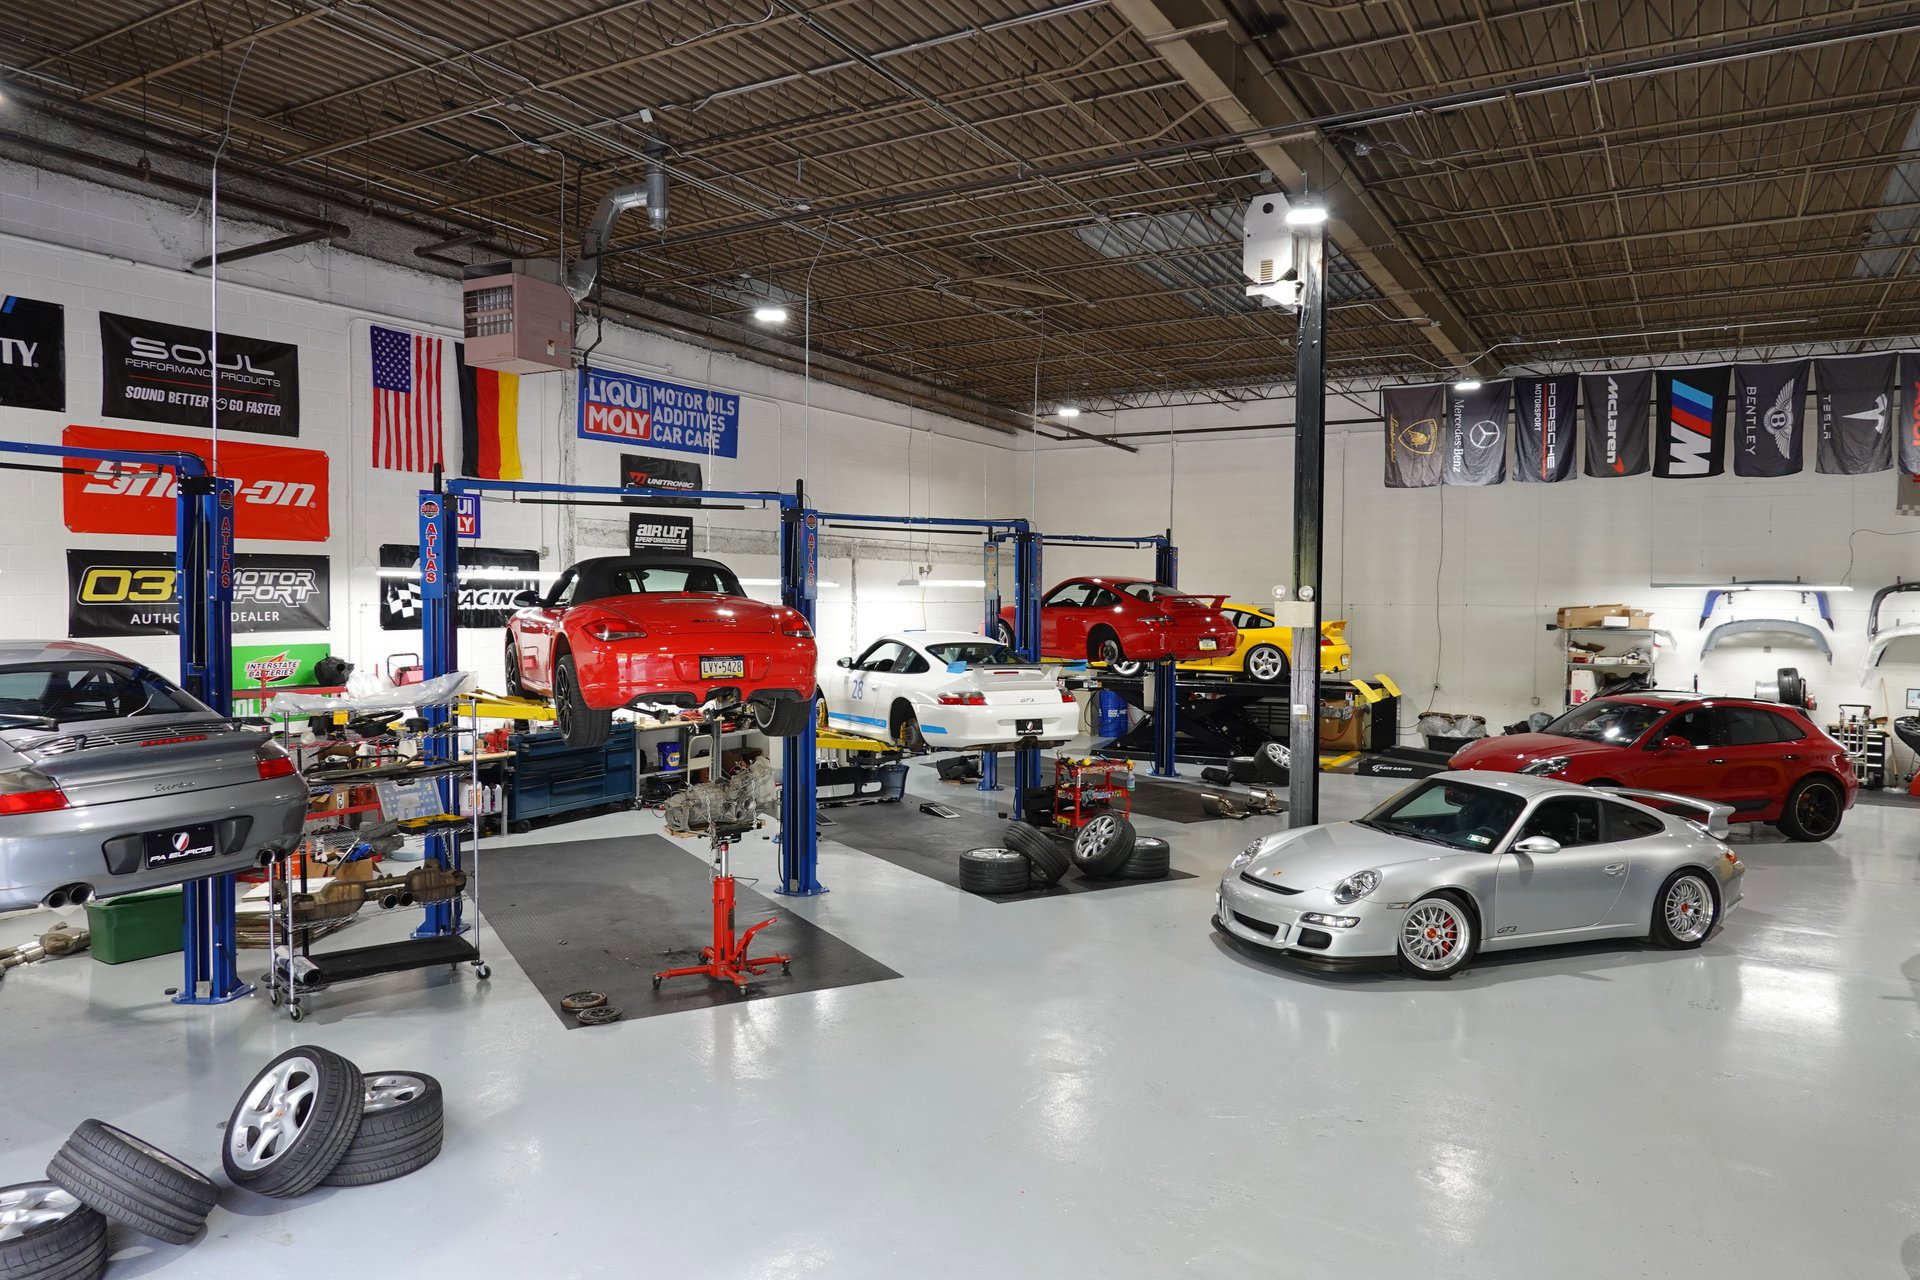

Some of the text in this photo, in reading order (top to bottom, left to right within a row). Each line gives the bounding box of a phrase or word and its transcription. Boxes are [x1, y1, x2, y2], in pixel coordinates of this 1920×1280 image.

[130, 336, 275, 376] SOUL
[125, 357, 281, 388] PERFORMANCE PRODUCTS
[125, 385, 281, 417] SOUND BETTER GO FASTER
[588, 377, 648, 410] LIQUI
[653, 386, 735, 416] MOTOR OILS
[1533, 383, 1542, 432] MOTORSPORT
[588, 406, 650, 436] MOLY
[653, 406, 726, 432] ADDITIVES
[1546, 382, 1556, 469] PORSCHE
[1745, 386, 1757, 455] BENTLEY
[1823, 395, 1832, 440] TESLA
[653, 425, 721, 450] CAR CARE
[1453, 399, 1465, 472] Mercedes-Benz
[82, 460, 316, 507] Sn-on
[647, 478, 695, 489] UNITRONIC
[457, 517, 473, 532] LY
[220, 516, 231, 588] ATLAS
[425, 522, 438, 583] ATLAS
[807, 533, 815, 587] ATLAS
[82, 569, 177, 602] 03
[458, 589, 516, 608] ACIN
[231, 611, 280, 622] DEALER
[247, 661, 298, 670] INTERSTATE
[249, 669, 294, 678] BATERIES
[852, 679, 864, 700] 28
[153, 781, 195, 792] Turbo
[150, 845, 213, 863] PA EUROS
[1497, 925, 1517, 934] GT3
